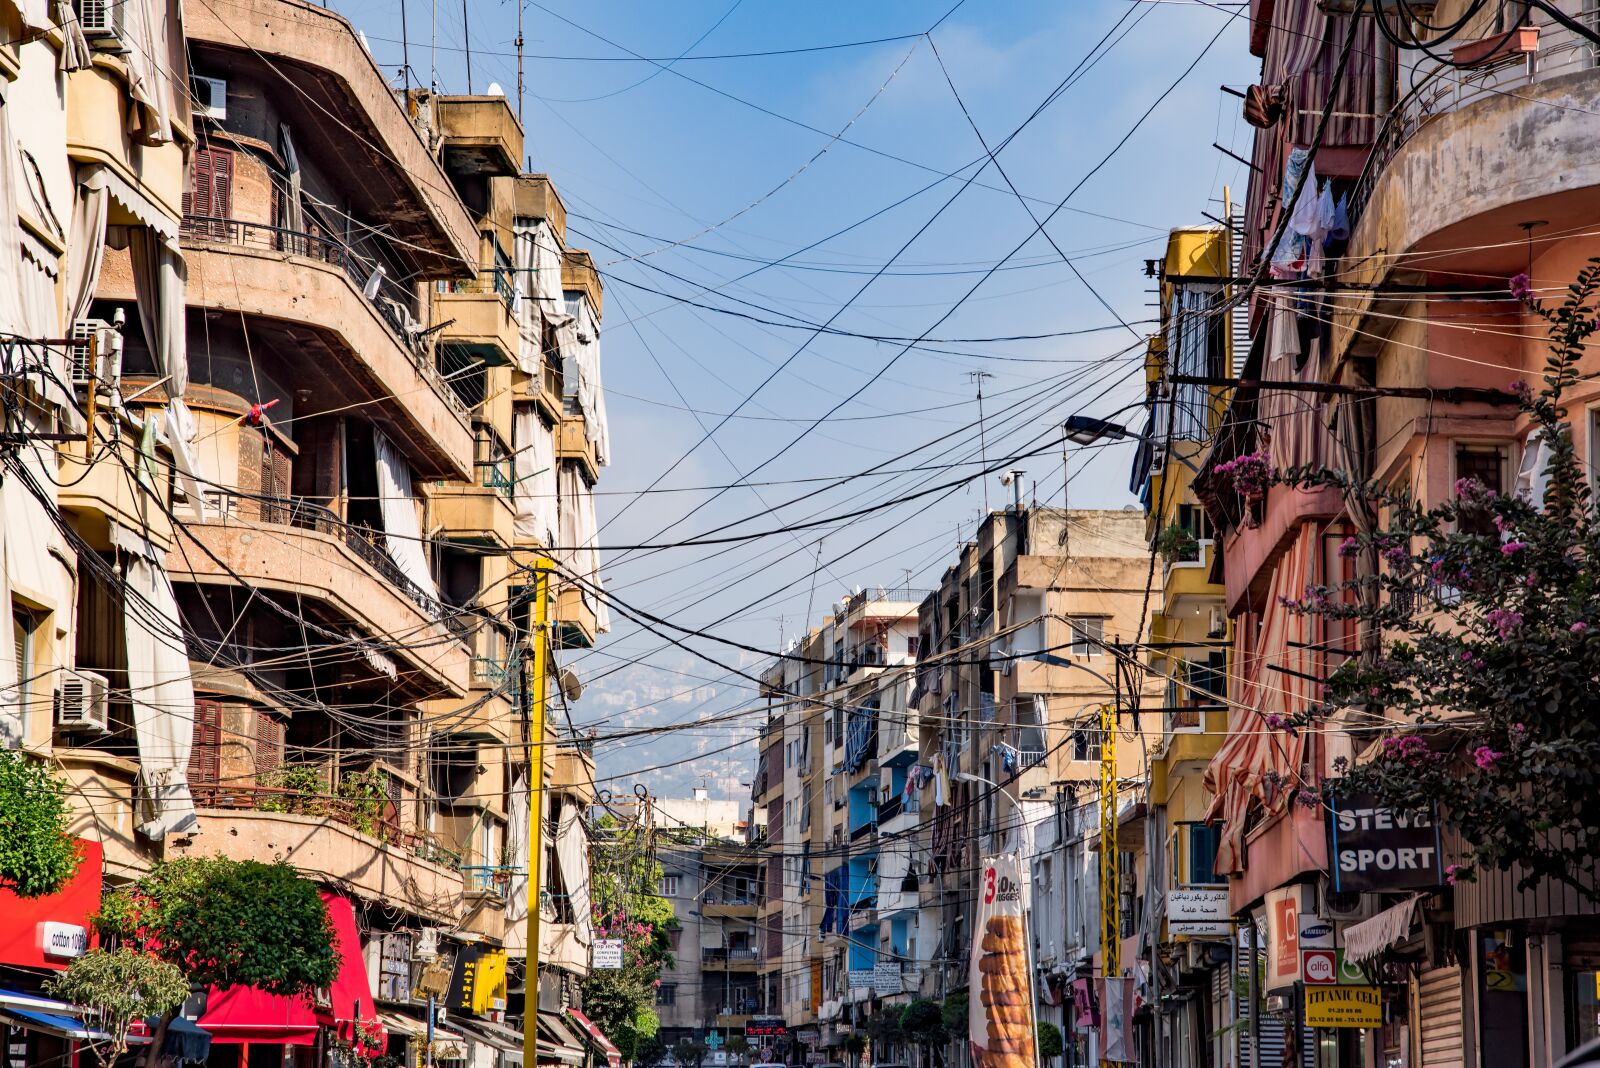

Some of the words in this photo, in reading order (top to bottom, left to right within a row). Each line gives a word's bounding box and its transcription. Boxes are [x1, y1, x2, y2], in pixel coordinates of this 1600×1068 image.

[1339, 847, 1435, 872] SPORT
[1181, 904, 1197, 913] عامة
[1200, 905, 1218, 913] صحة
[1304, 927, 1330, 935] SAMSUNG
[51, 931, 71, 949] cotton
[1310, 961, 1329, 972] alfa
[461, 962, 475, 1008] MATRIX
[1308, 989, 1354, 1004] TITANIC
[1356, 990, 1381, 1007] CELL
